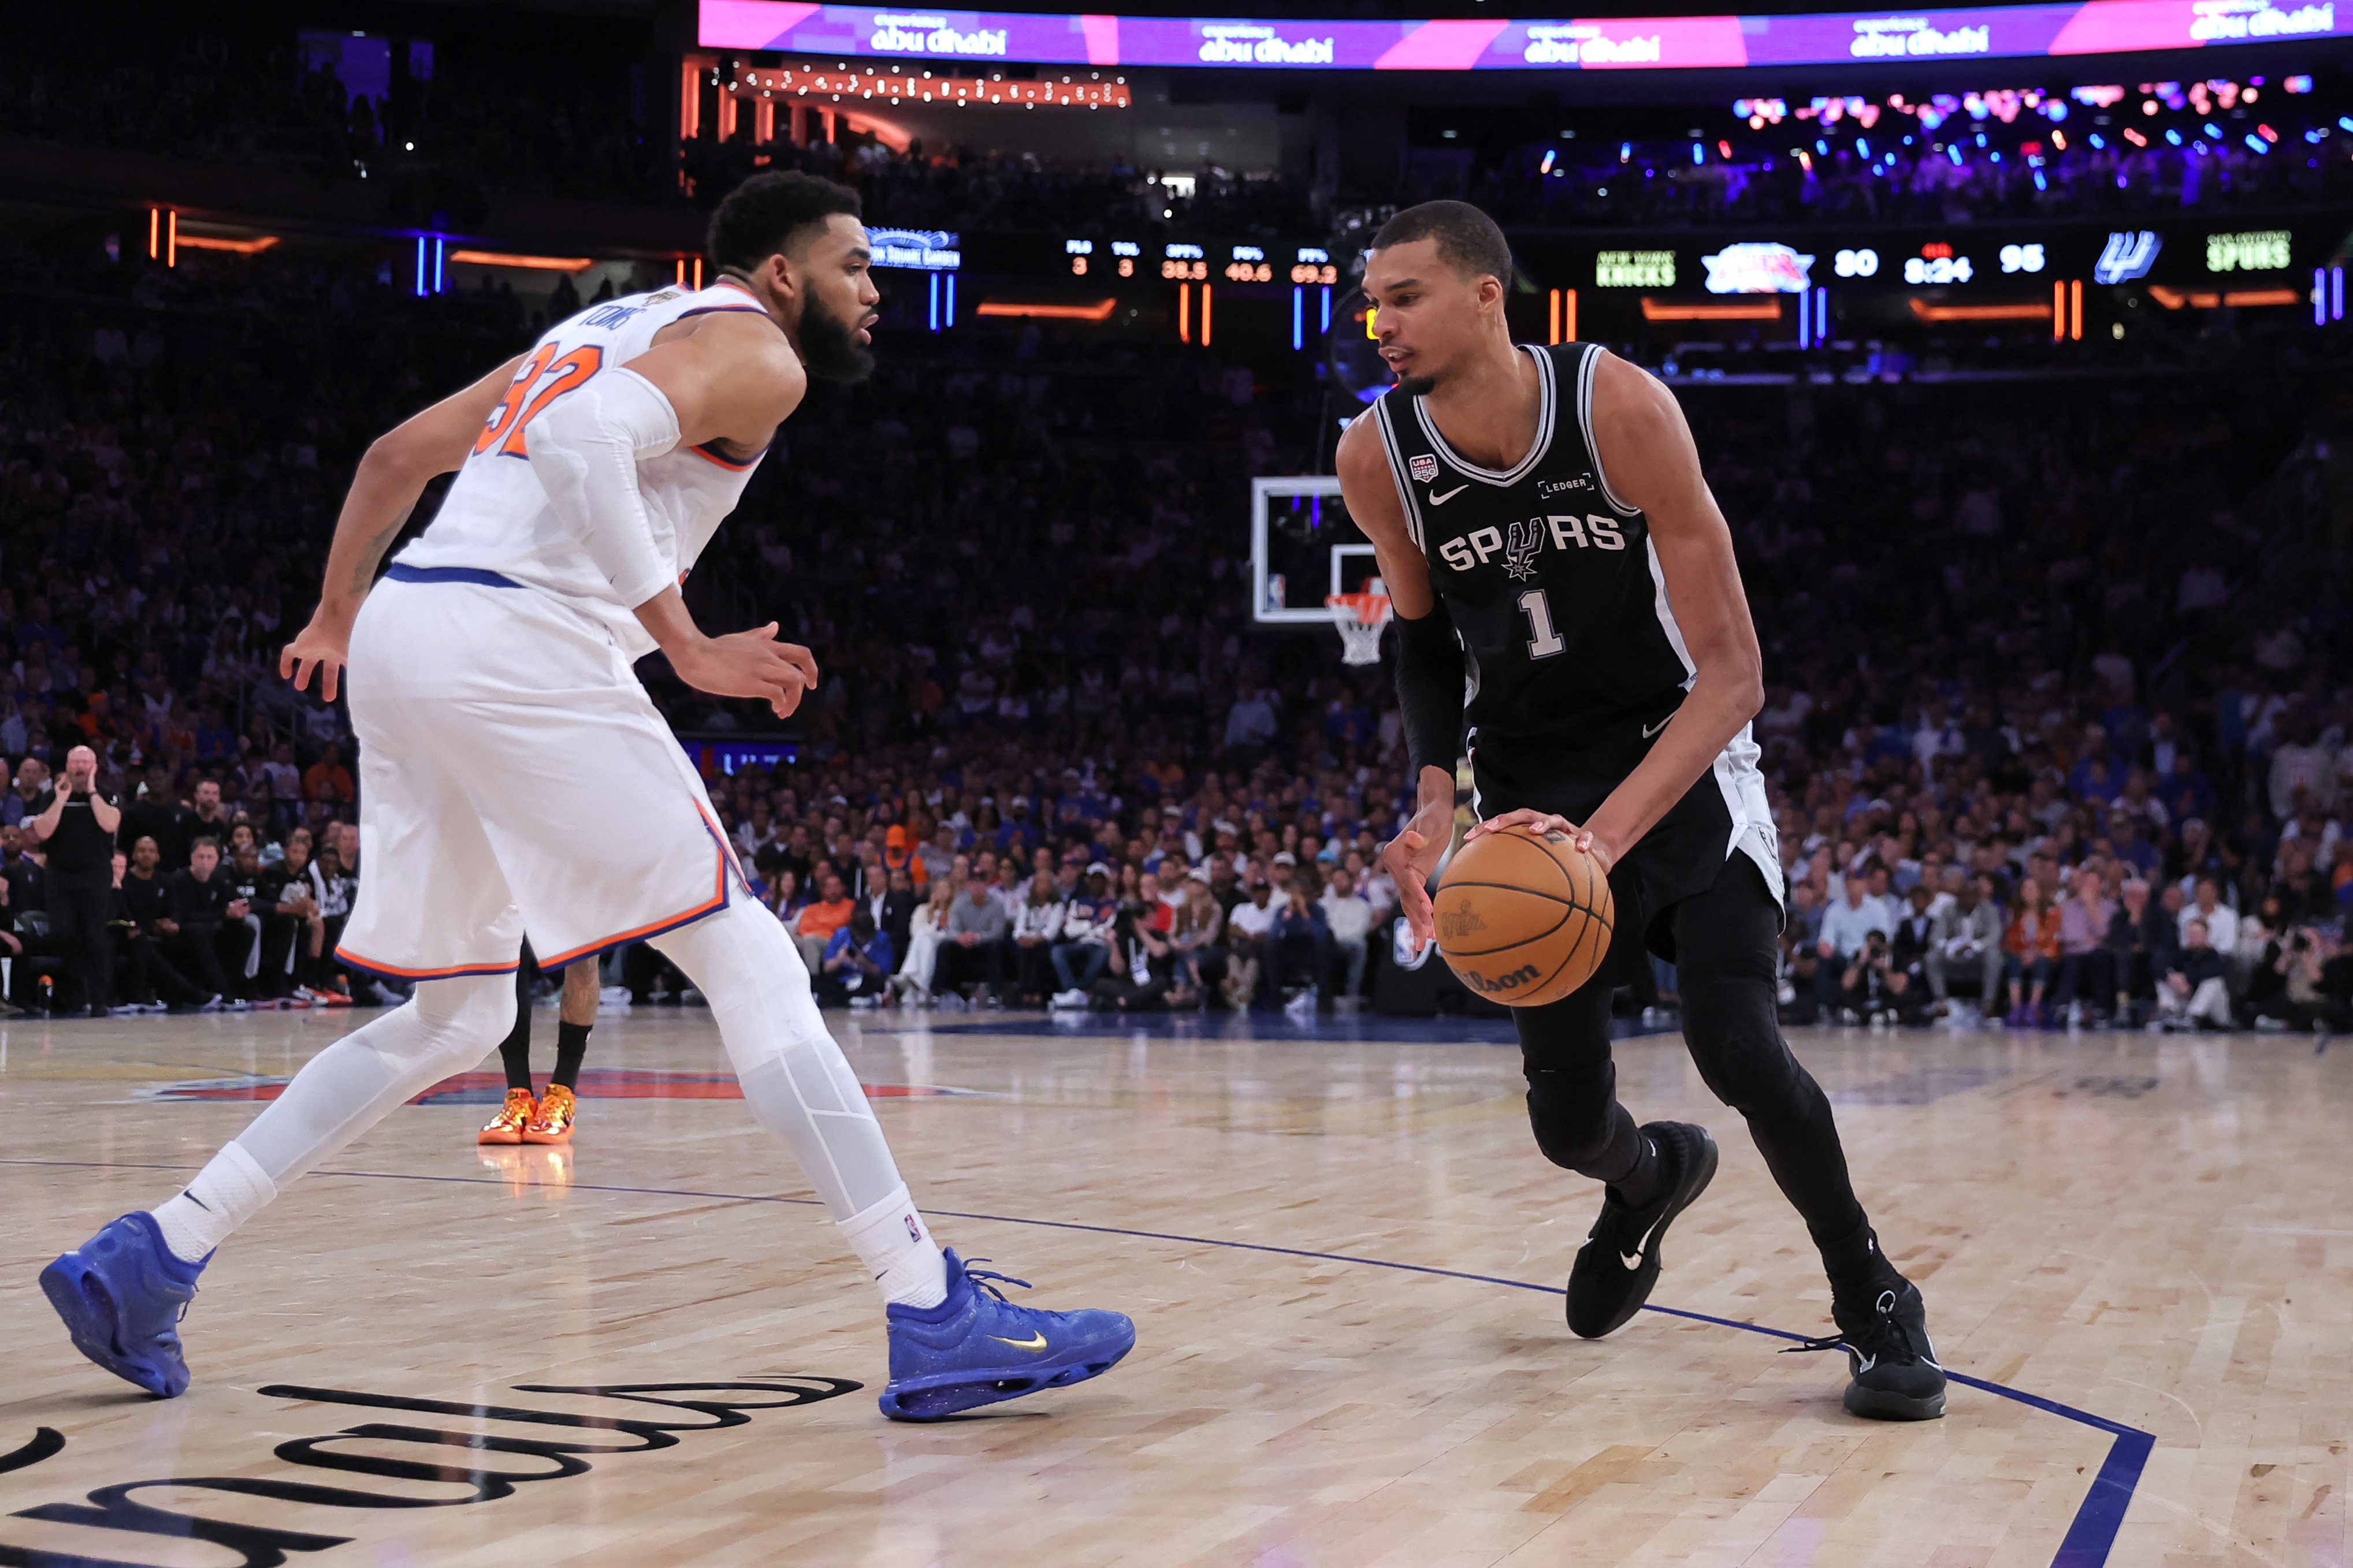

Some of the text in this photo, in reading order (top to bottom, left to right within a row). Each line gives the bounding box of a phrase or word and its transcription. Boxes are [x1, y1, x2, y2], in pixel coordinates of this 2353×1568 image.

[871, 28, 1007, 55] abu dhabi
[1198, 37, 1335, 64] abu dhabi
[1524, 36, 1660, 63] abu dhabi
[1850, 25, 1989, 57] abu dhabi
[1596, 263, 1676, 287] KNICKS
[1835, 244, 2045, 284] 80 8:24 95
[473, 341, 604, 461] 32
[1412, 458, 1433, 467] USA
[1414, 468, 1436, 478] 250
[1545, 478, 1587, 493] LEDGER
[1440, 513, 1626, 582] SPURS
[1517, 589, 1566, 660] 1
